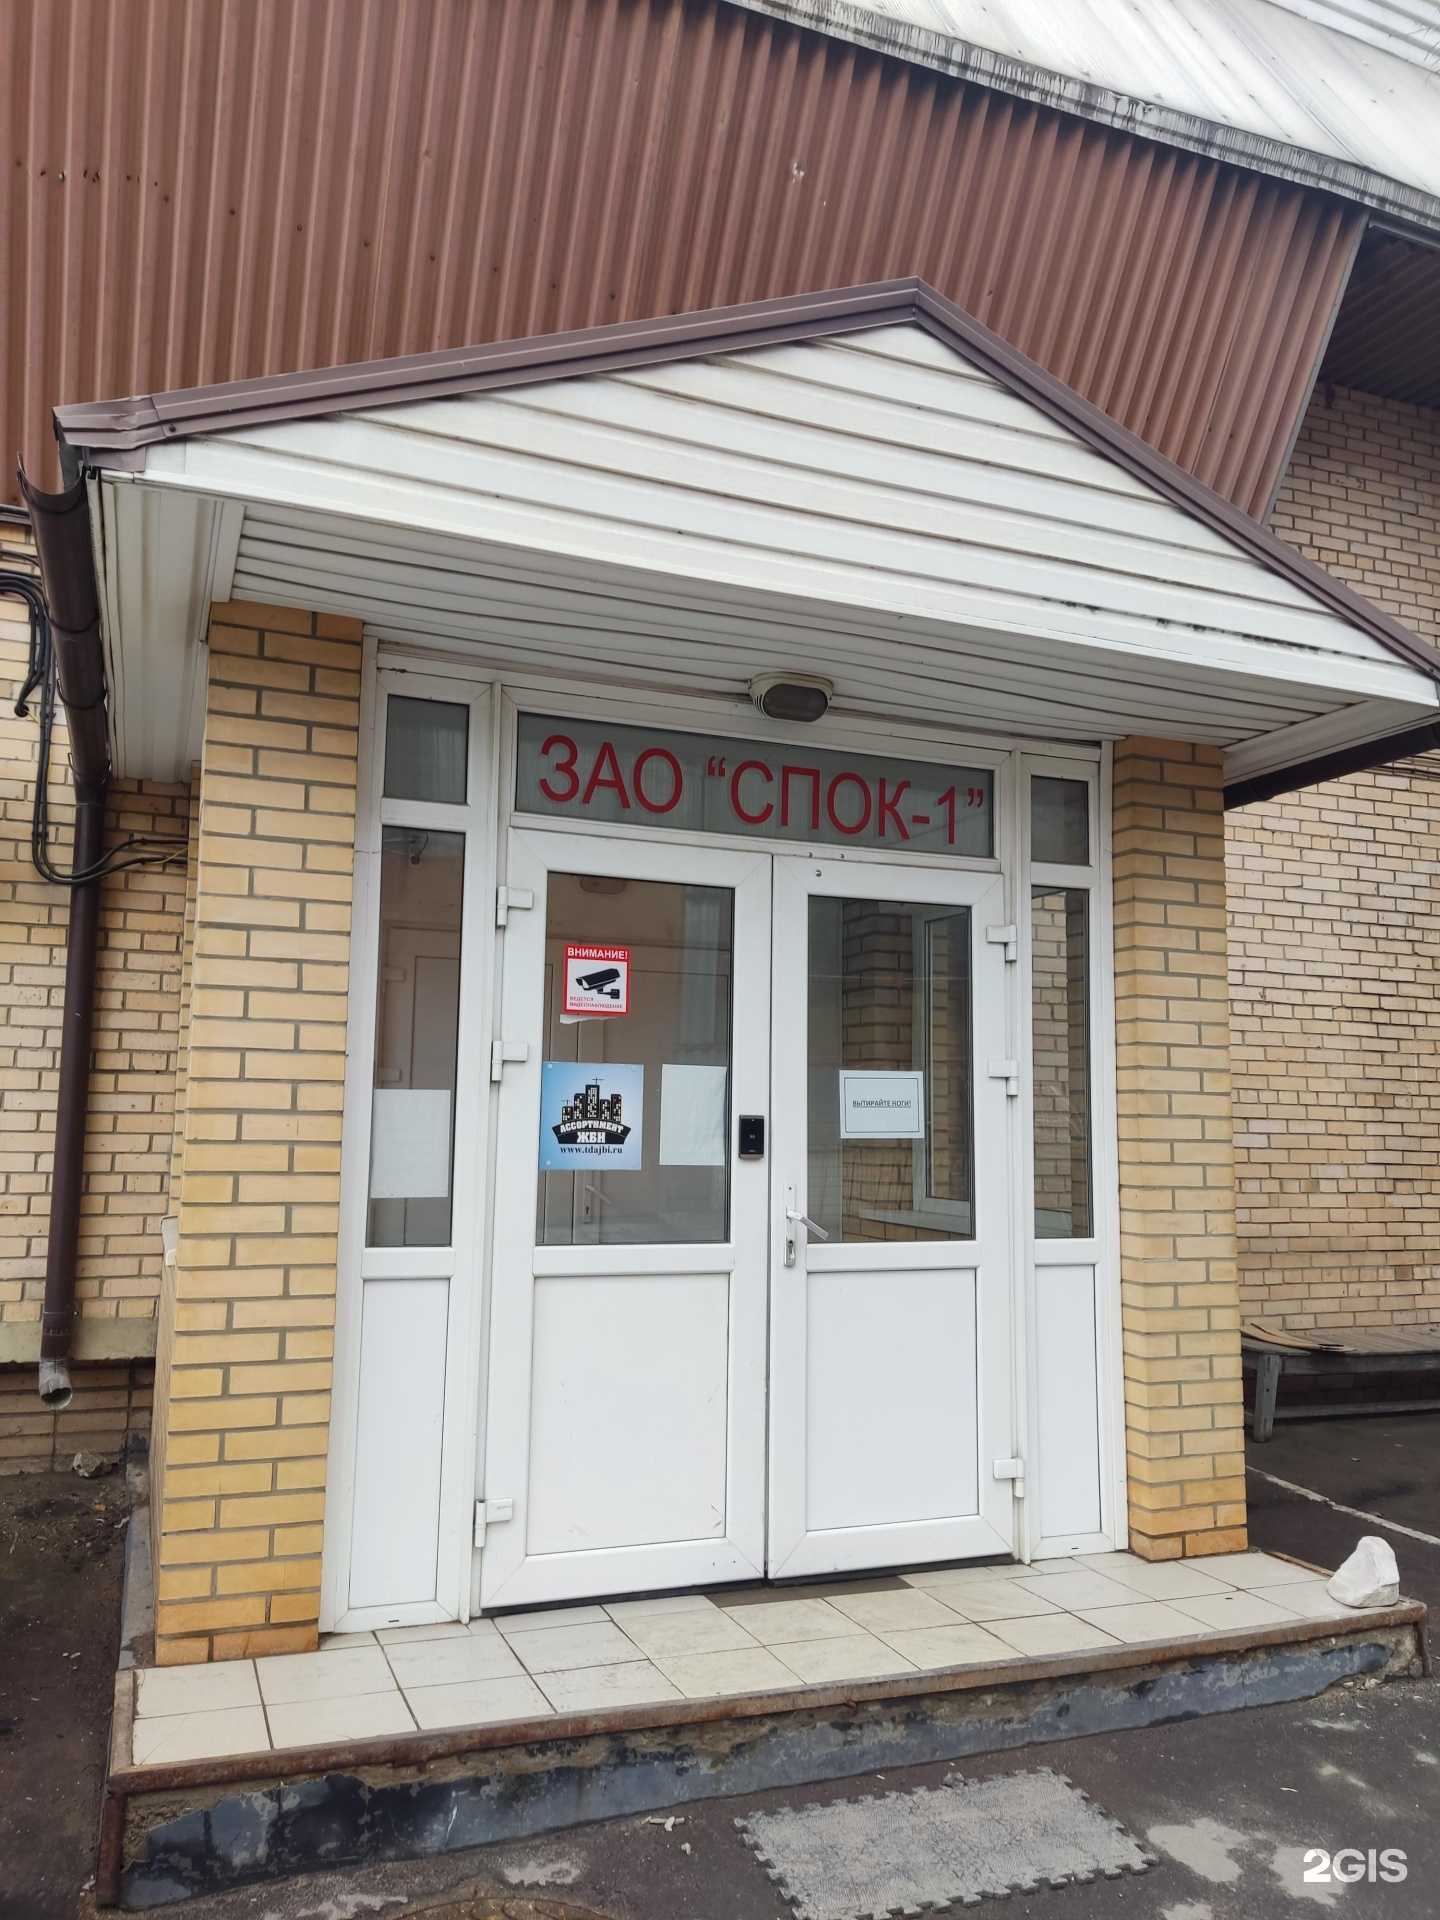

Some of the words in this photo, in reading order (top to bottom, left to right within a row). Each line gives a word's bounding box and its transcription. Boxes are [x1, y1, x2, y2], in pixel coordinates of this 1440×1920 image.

[538, 734, 683, 813] ЗАО
[567, 946, 628, 960] ВНИМАНИЕ!
[852, 1098, 891, 1108] ВЫТИРАЙТЕ
[560, 1120, 624, 1134] АССОРТИМЕНТ
[576, 1131, 606, 1143] ЖБИ
[560, 1145, 623, 1155] www.tdajbi.ru
